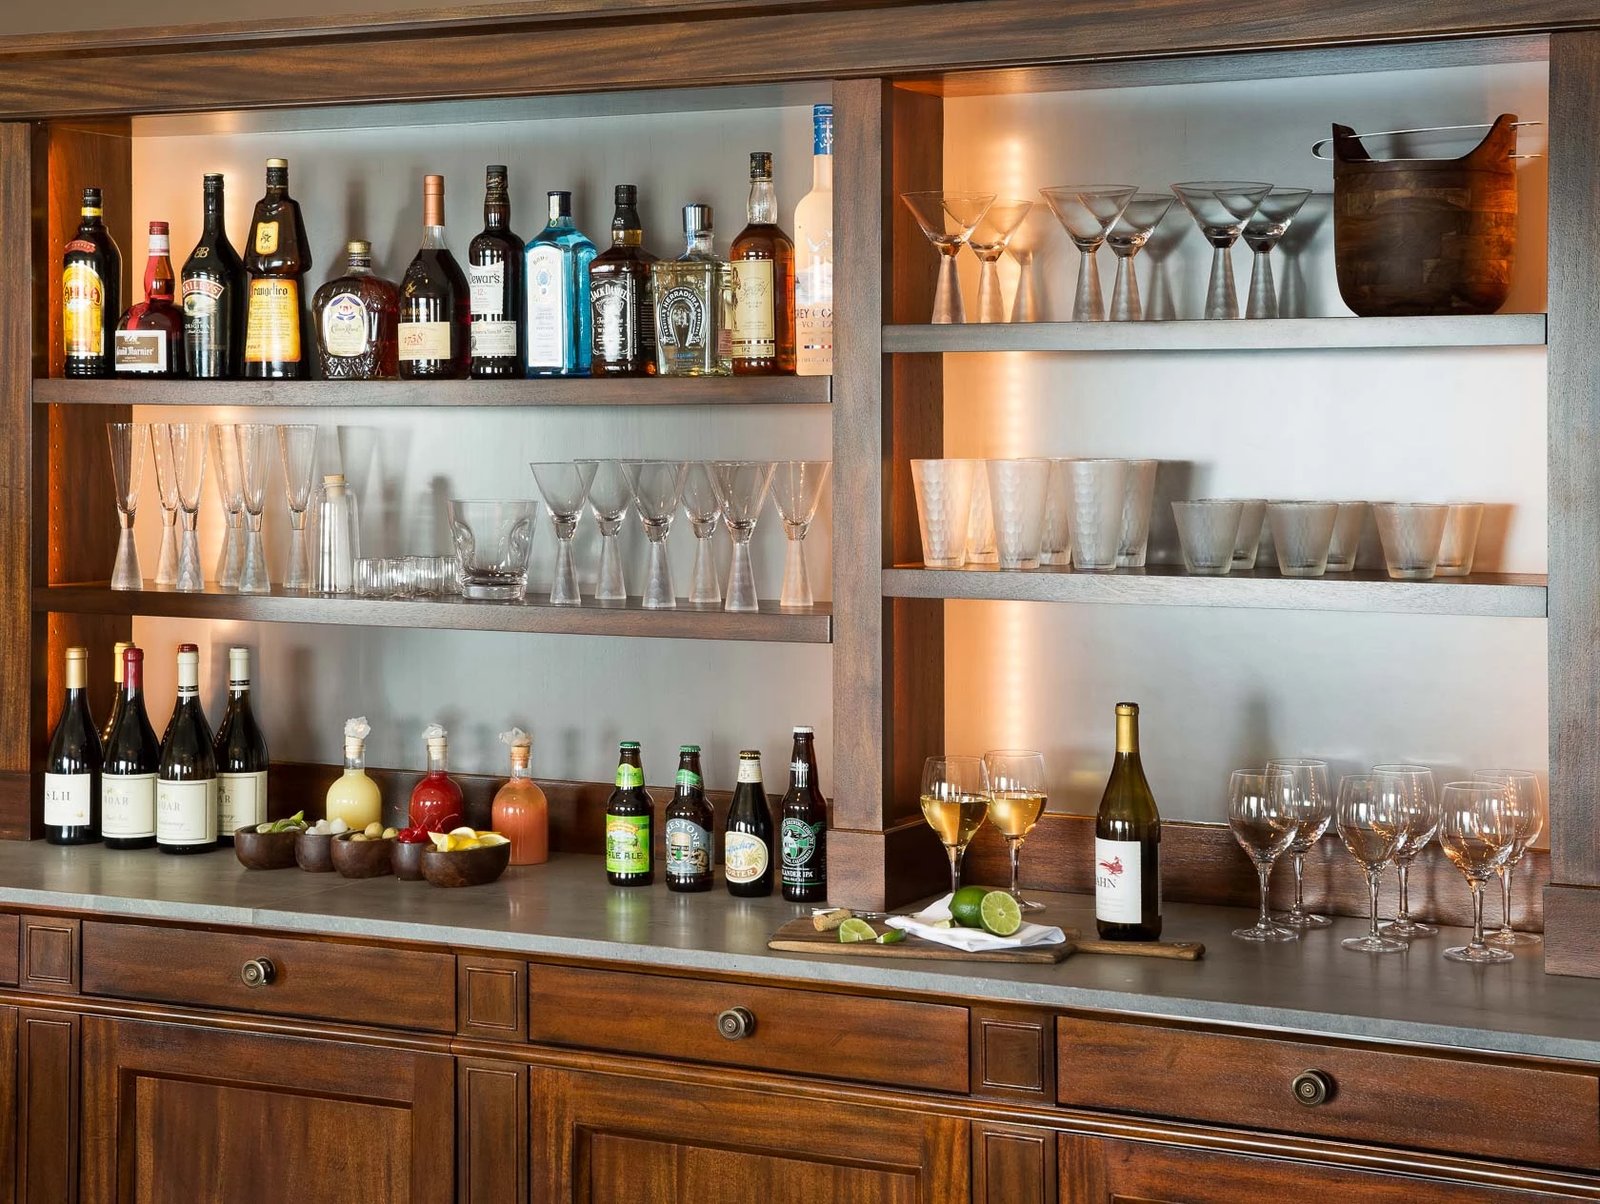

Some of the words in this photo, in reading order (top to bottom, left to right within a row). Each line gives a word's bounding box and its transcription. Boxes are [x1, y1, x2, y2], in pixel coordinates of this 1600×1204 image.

[590, 285, 605, 302] JACK
[663, 290, 700, 308] HERRADURA
[624, 852, 643, 860] ALE
